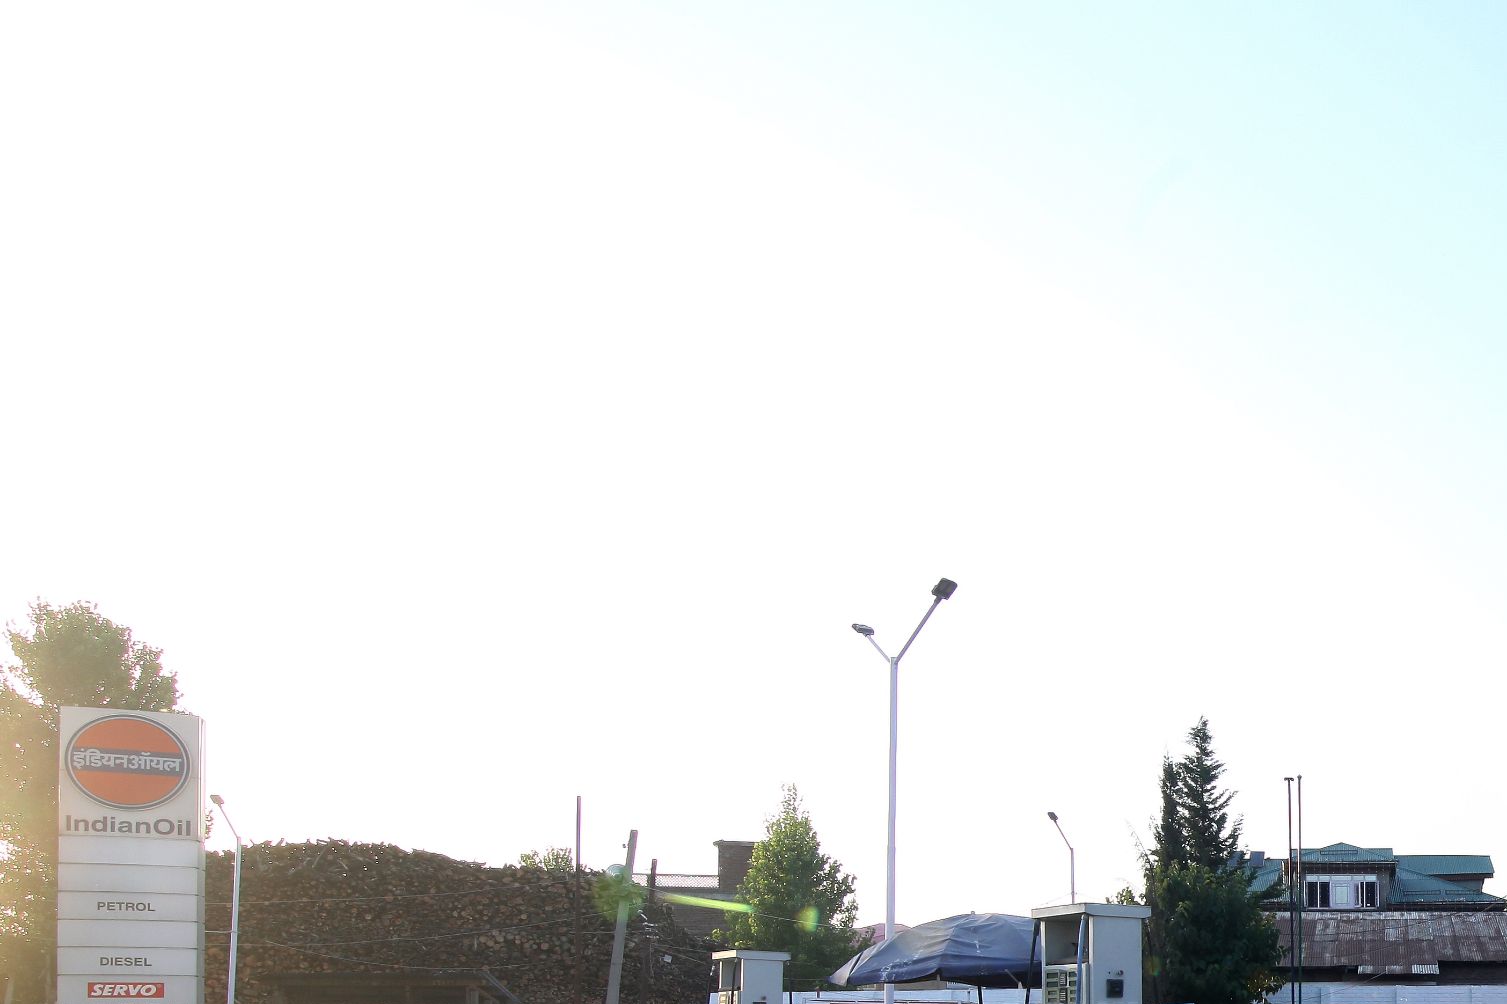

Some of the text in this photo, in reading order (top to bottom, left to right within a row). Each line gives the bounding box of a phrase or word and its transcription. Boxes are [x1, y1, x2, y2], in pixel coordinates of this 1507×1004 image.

[73, 748, 181, 772] इंडियनऑयल
[65, 815, 191, 836] IndianOil
[97, 901, 156, 912] PETROL
[100, 956, 152, 967] DIESEL
[91, 984, 157, 996] SERVO
